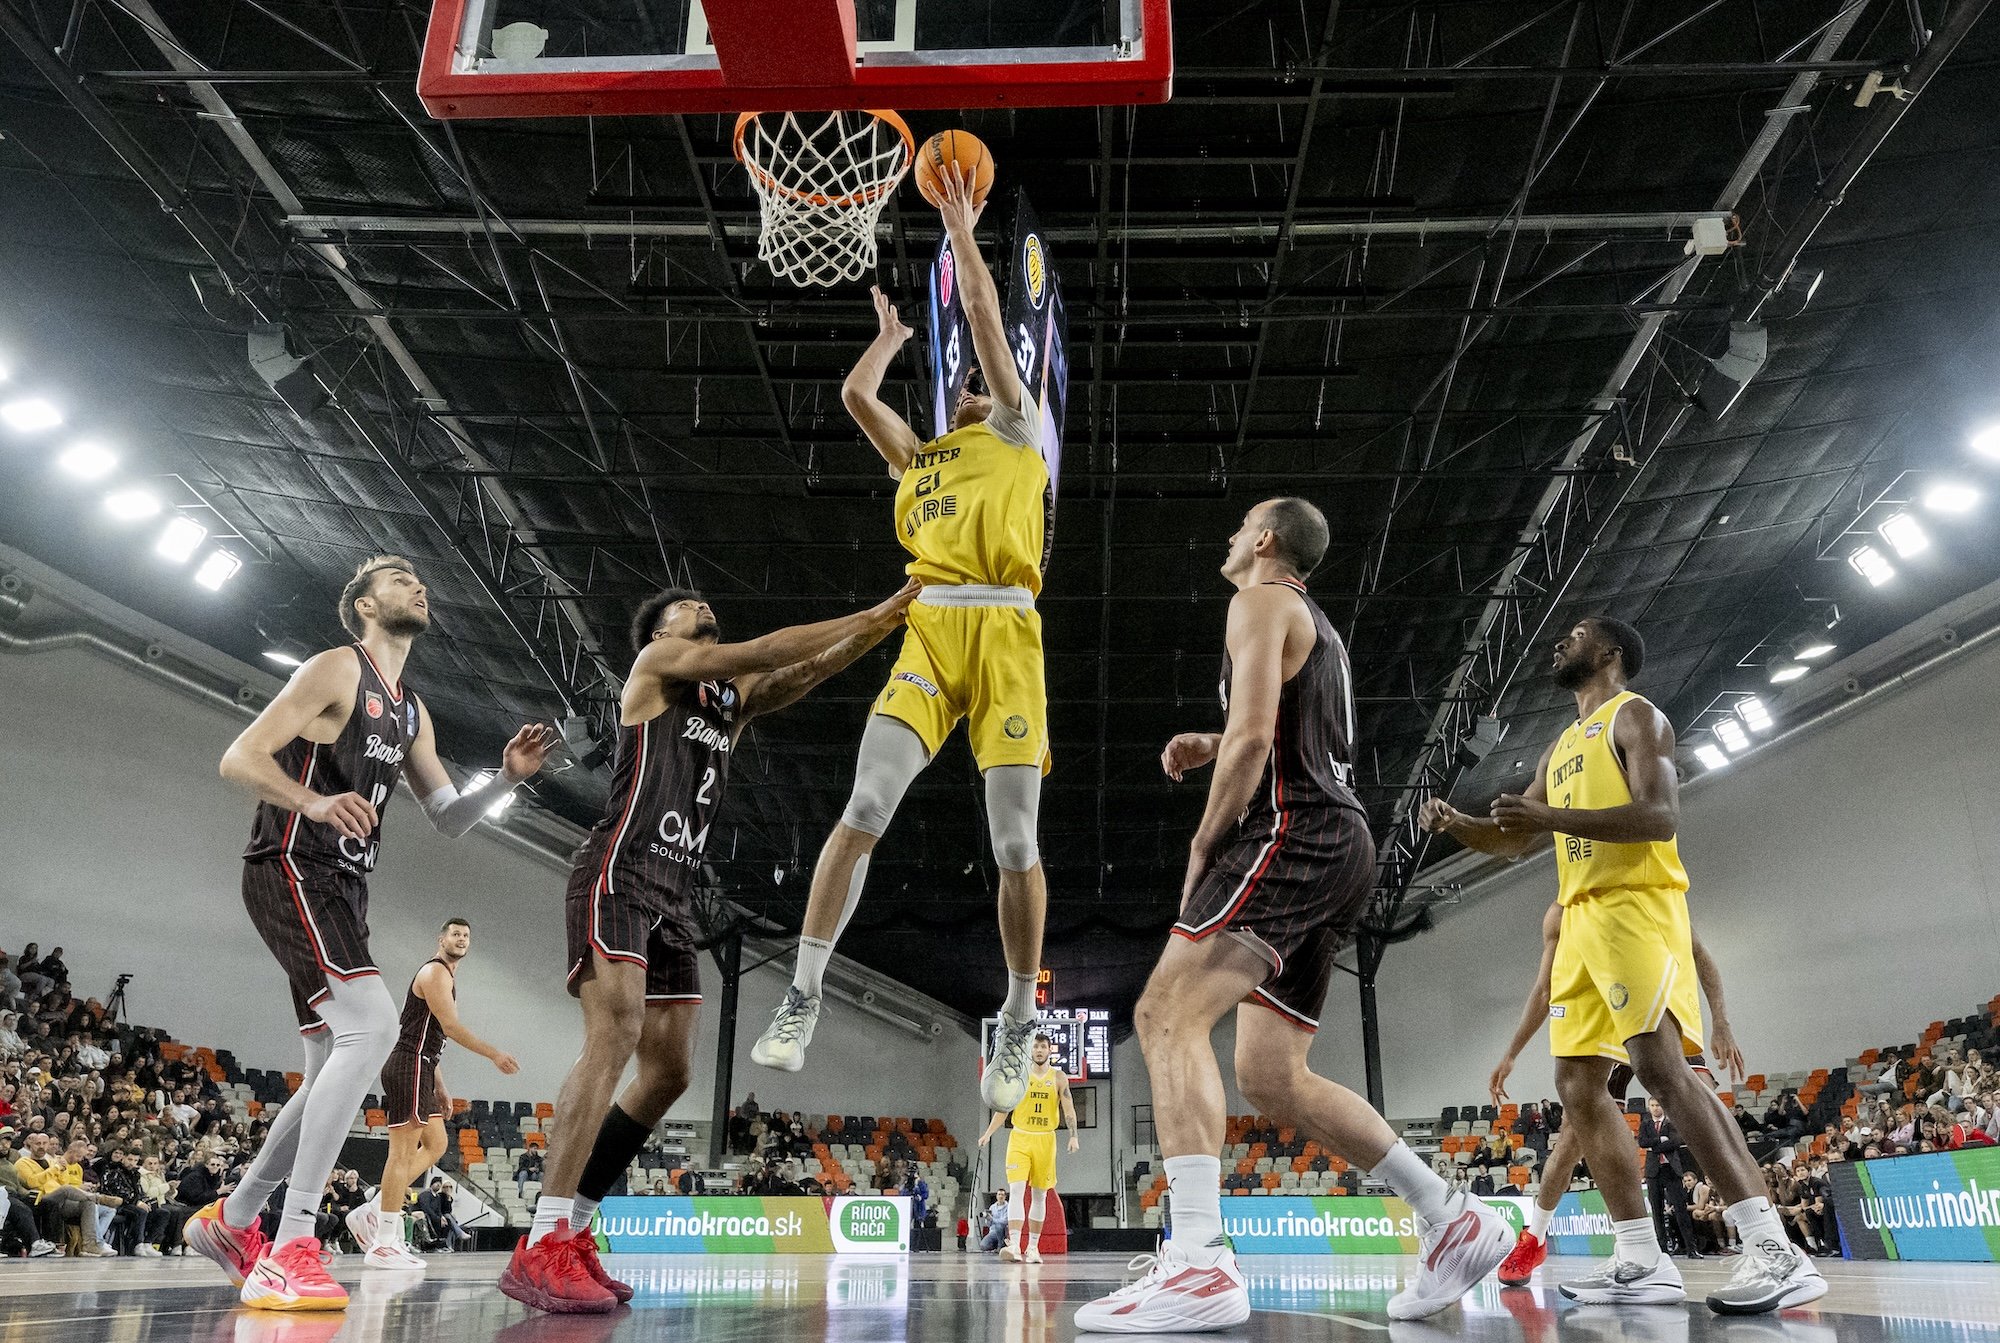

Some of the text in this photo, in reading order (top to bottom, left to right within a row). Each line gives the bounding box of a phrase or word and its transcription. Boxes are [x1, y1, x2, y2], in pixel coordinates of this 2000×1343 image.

[946, 324, 960, 388] 33
[1017, 323, 1035, 385] 37
[915, 470, 941, 497] 21
[905, 673, 938, 696] TIPOS
[1553, 754, 1584, 788] INTER
[696, 766, 716, 805] 2
[658, 810, 711, 854] CM
[1089, 1011, 1109, 1020] BAM
[1035, 1103, 1042, 1113] 11
[851, 1203, 891, 1220] RÍNOK
[850, 1219, 886, 1236] RAČA
